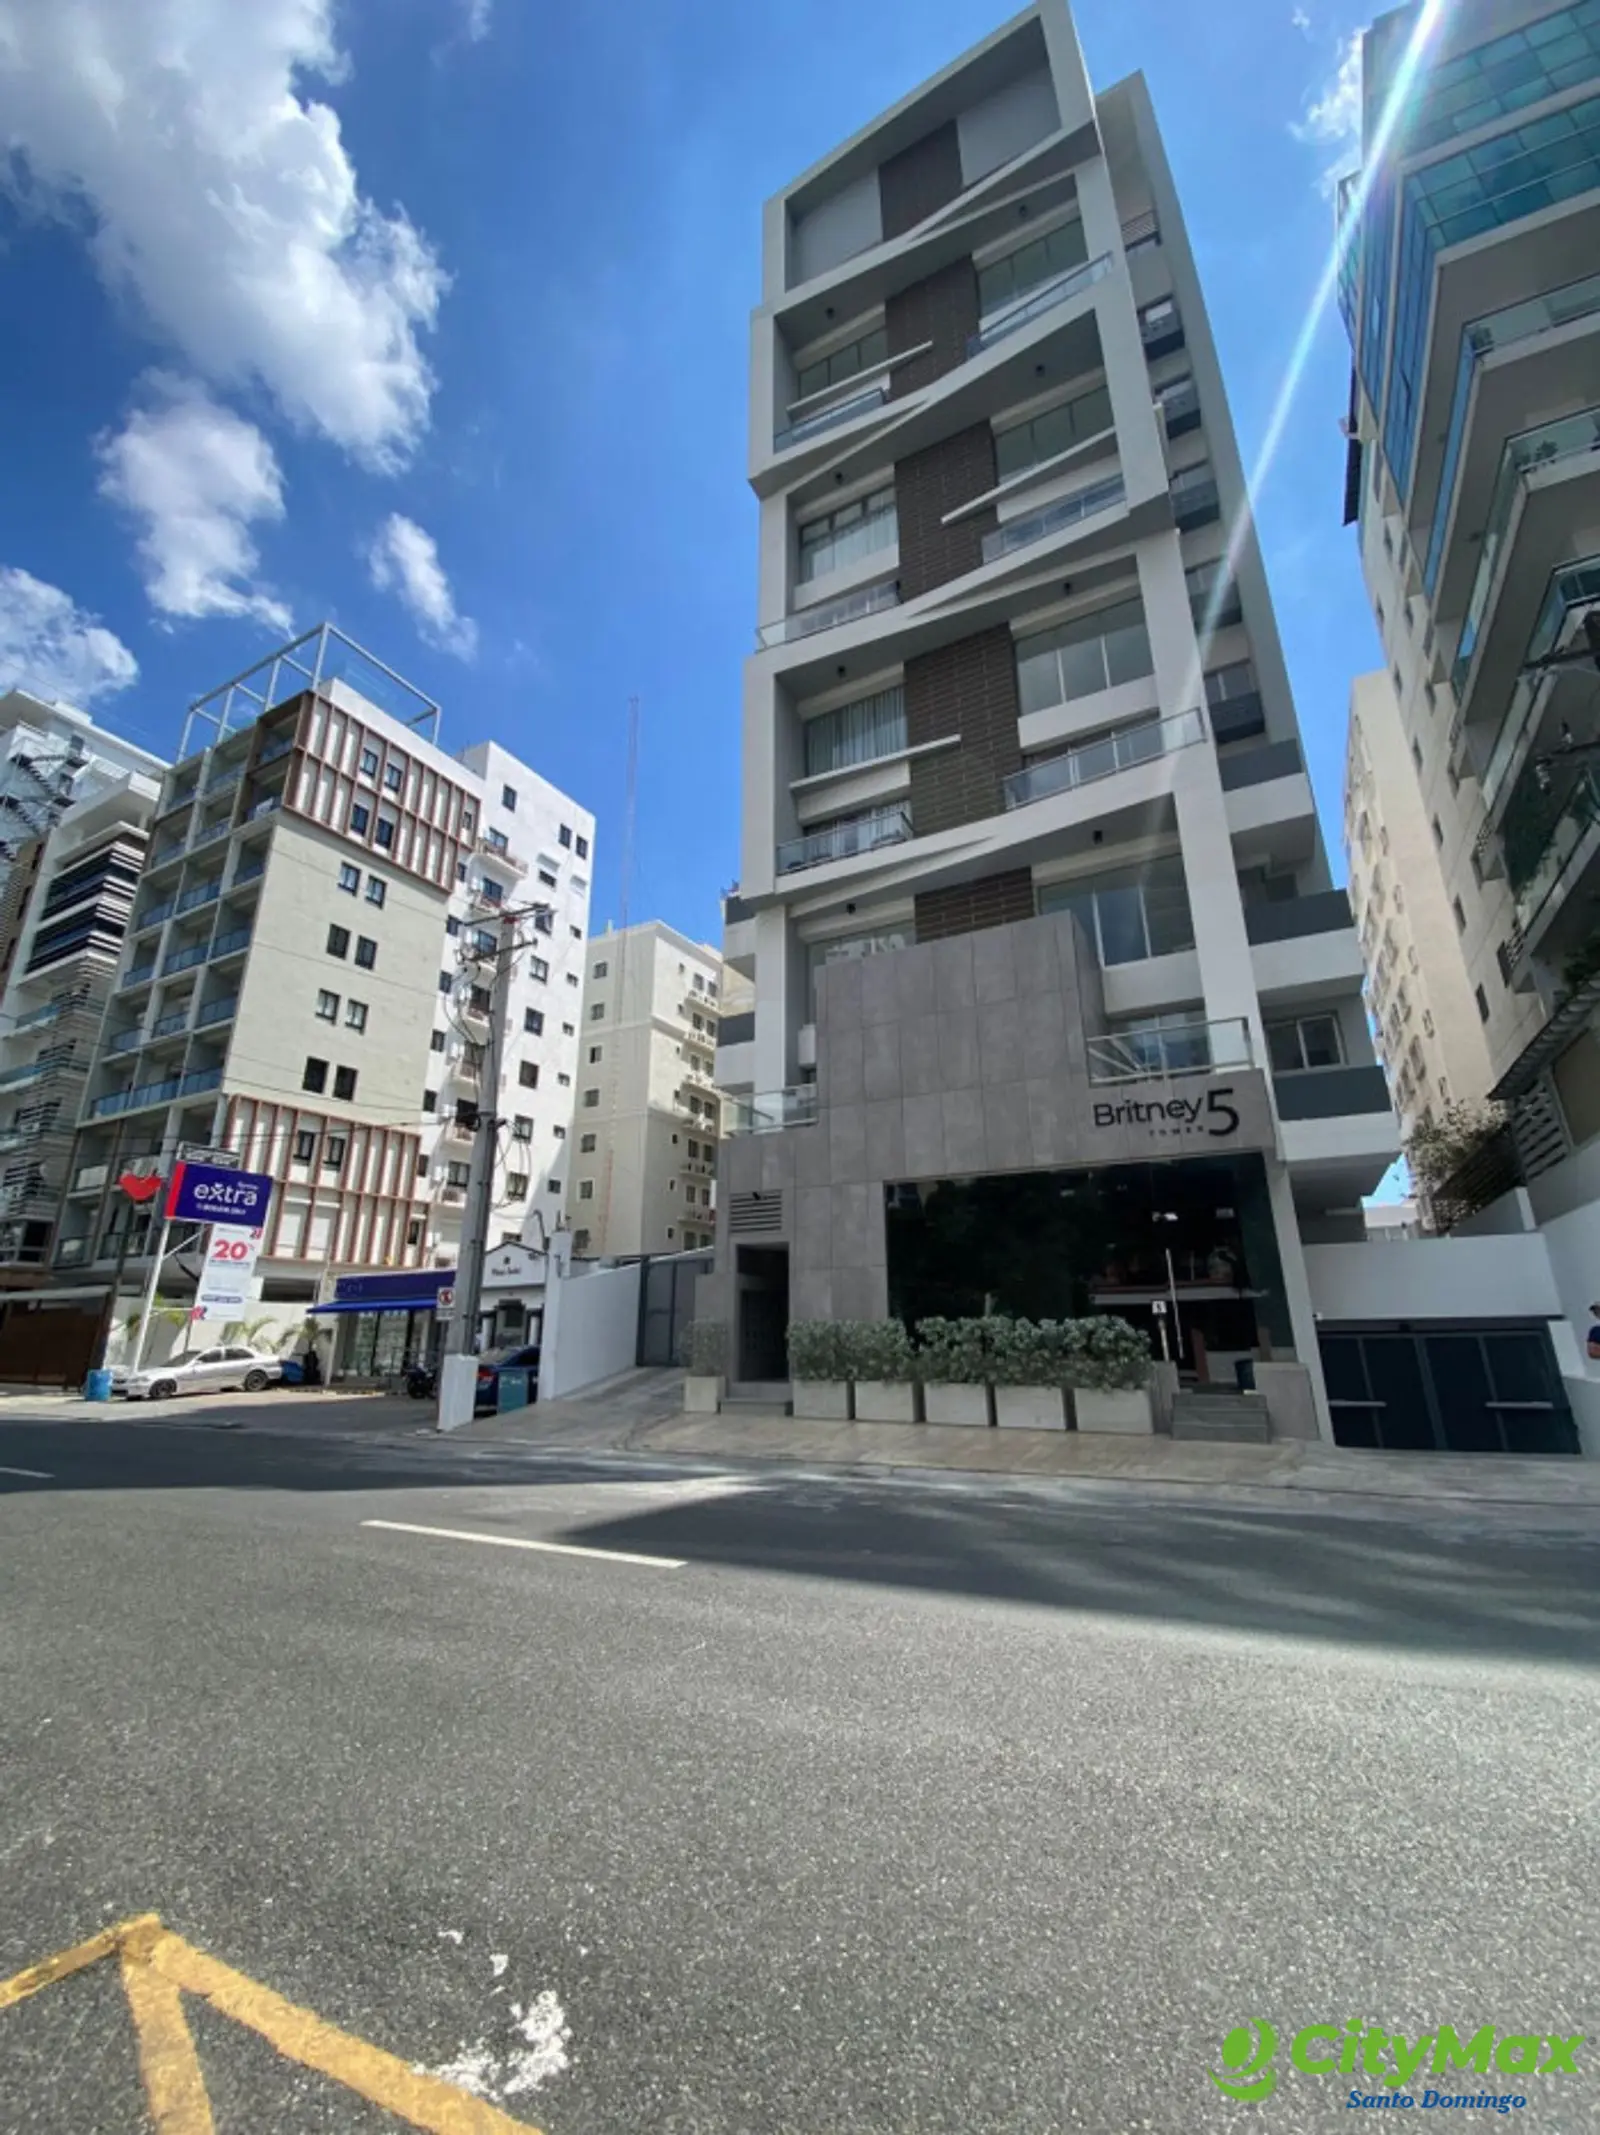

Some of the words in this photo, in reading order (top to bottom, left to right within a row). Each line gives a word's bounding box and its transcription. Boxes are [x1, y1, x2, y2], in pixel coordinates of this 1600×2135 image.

[1093, 1097, 1203, 1126] Britney
[1207, 1088, 1240, 1136] 5
[194, 1182, 258, 1206] extra
